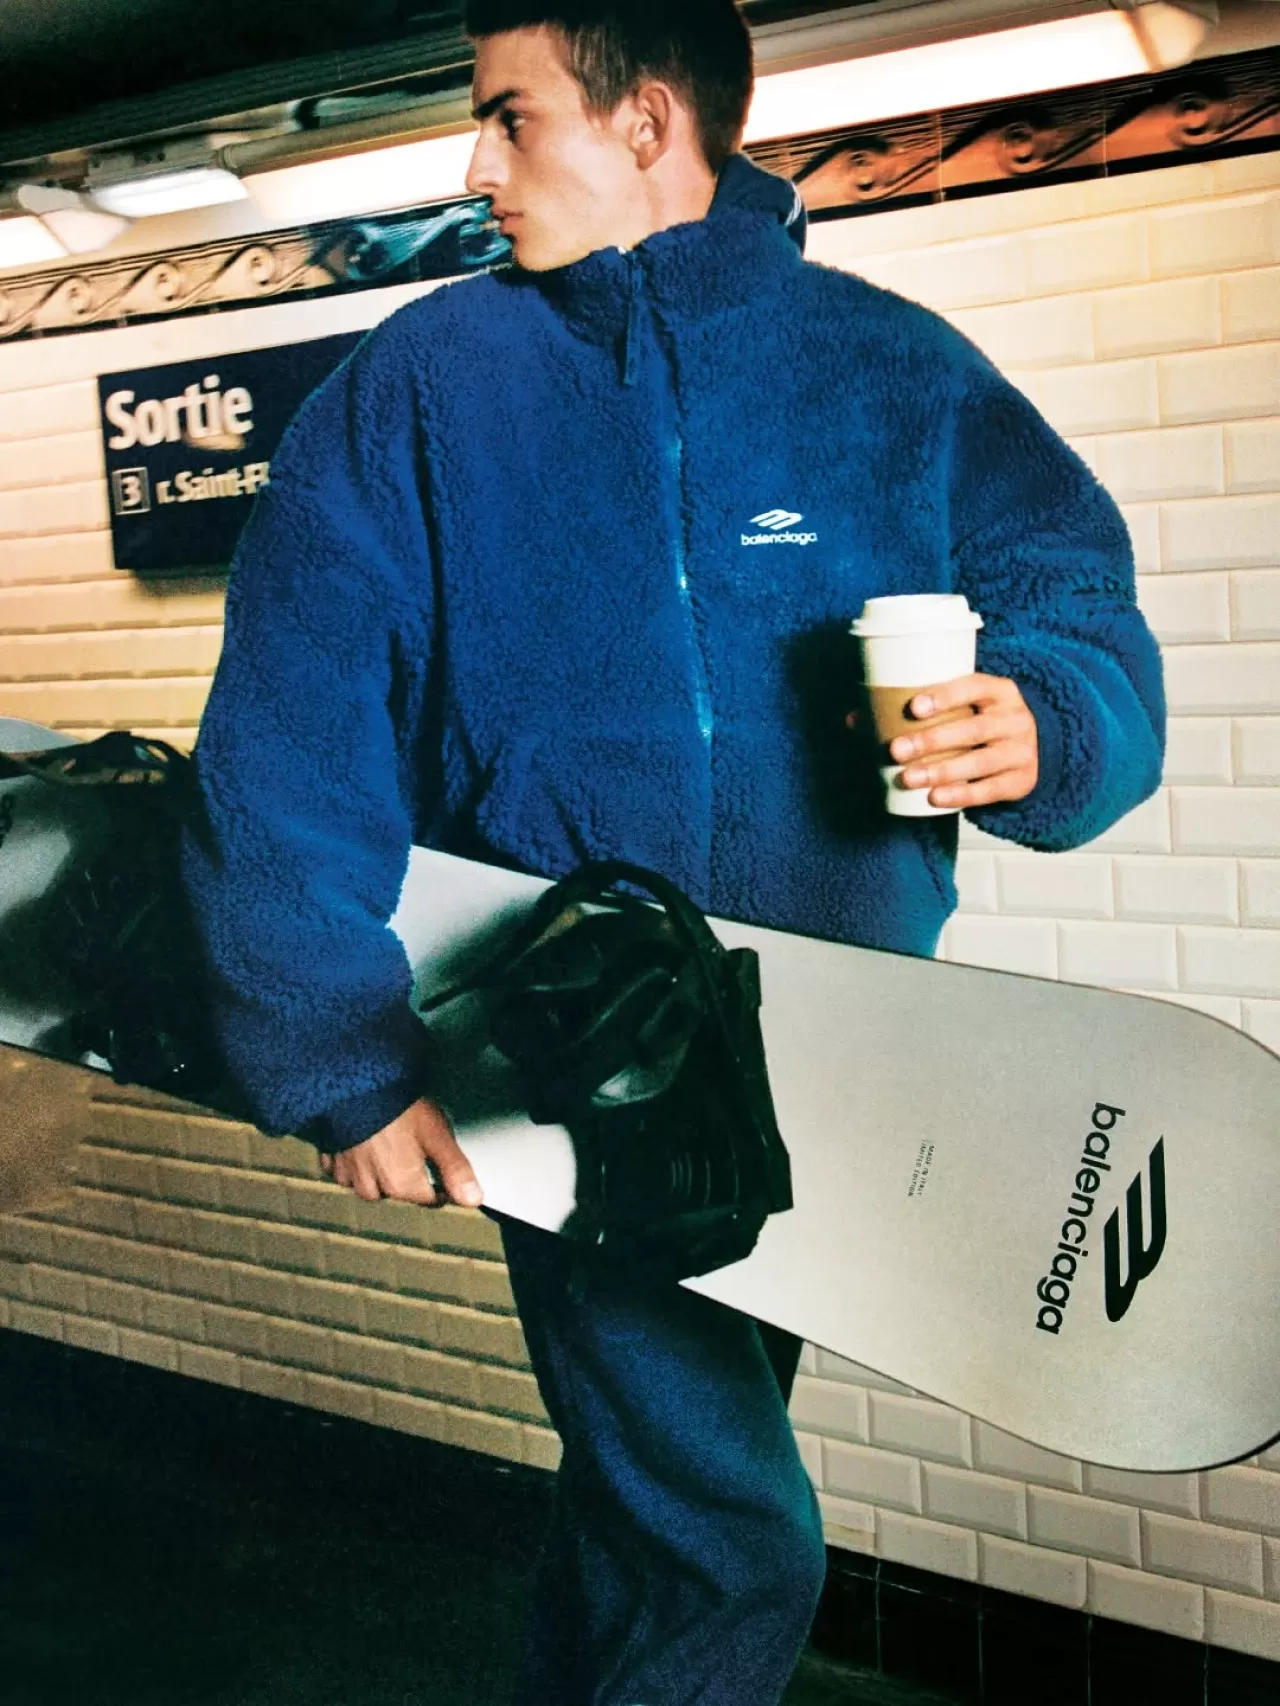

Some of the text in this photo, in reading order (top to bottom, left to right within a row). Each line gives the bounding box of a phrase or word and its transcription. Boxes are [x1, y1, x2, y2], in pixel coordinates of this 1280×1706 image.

[105, 374, 254, 450] Sortie
[120, 475, 142, 507] 3
[741, 530, 818, 546] balenciaga
[1036, 1103, 1126, 1335] balenciaga
